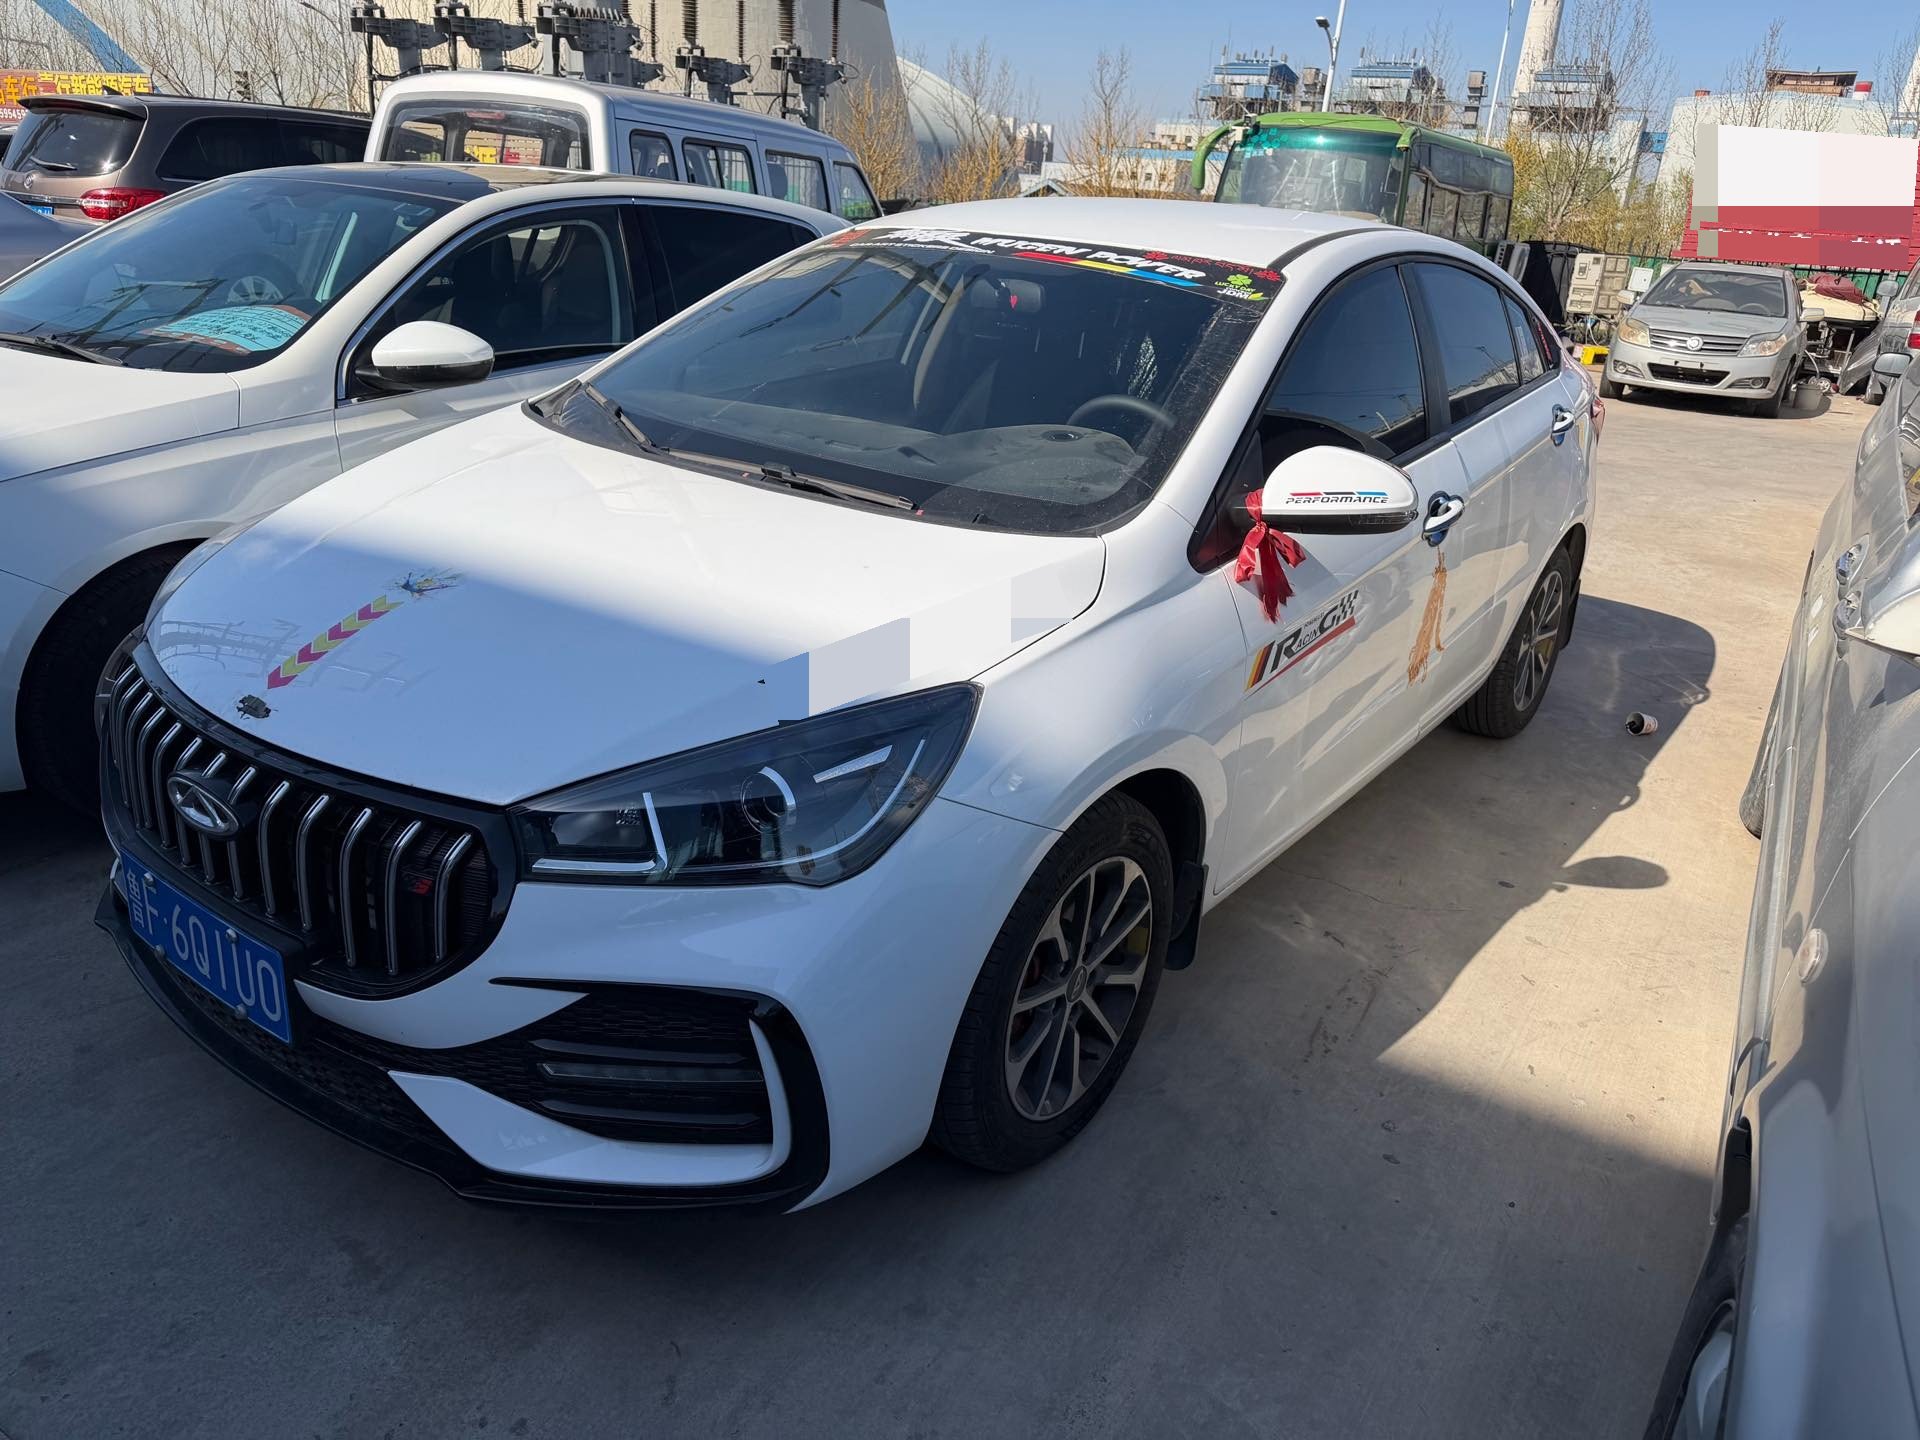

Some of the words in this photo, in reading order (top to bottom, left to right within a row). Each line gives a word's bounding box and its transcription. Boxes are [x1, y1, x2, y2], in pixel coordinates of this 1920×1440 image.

[970, 237, 1094, 255] MUGEN
[1086, 250, 1207, 280] POWER
[1214, 280, 1241, 289] LUCKY
[1217, 289, 1250, 299] JDM
[1285, 496, 1389, 504] PERFORMANCE
